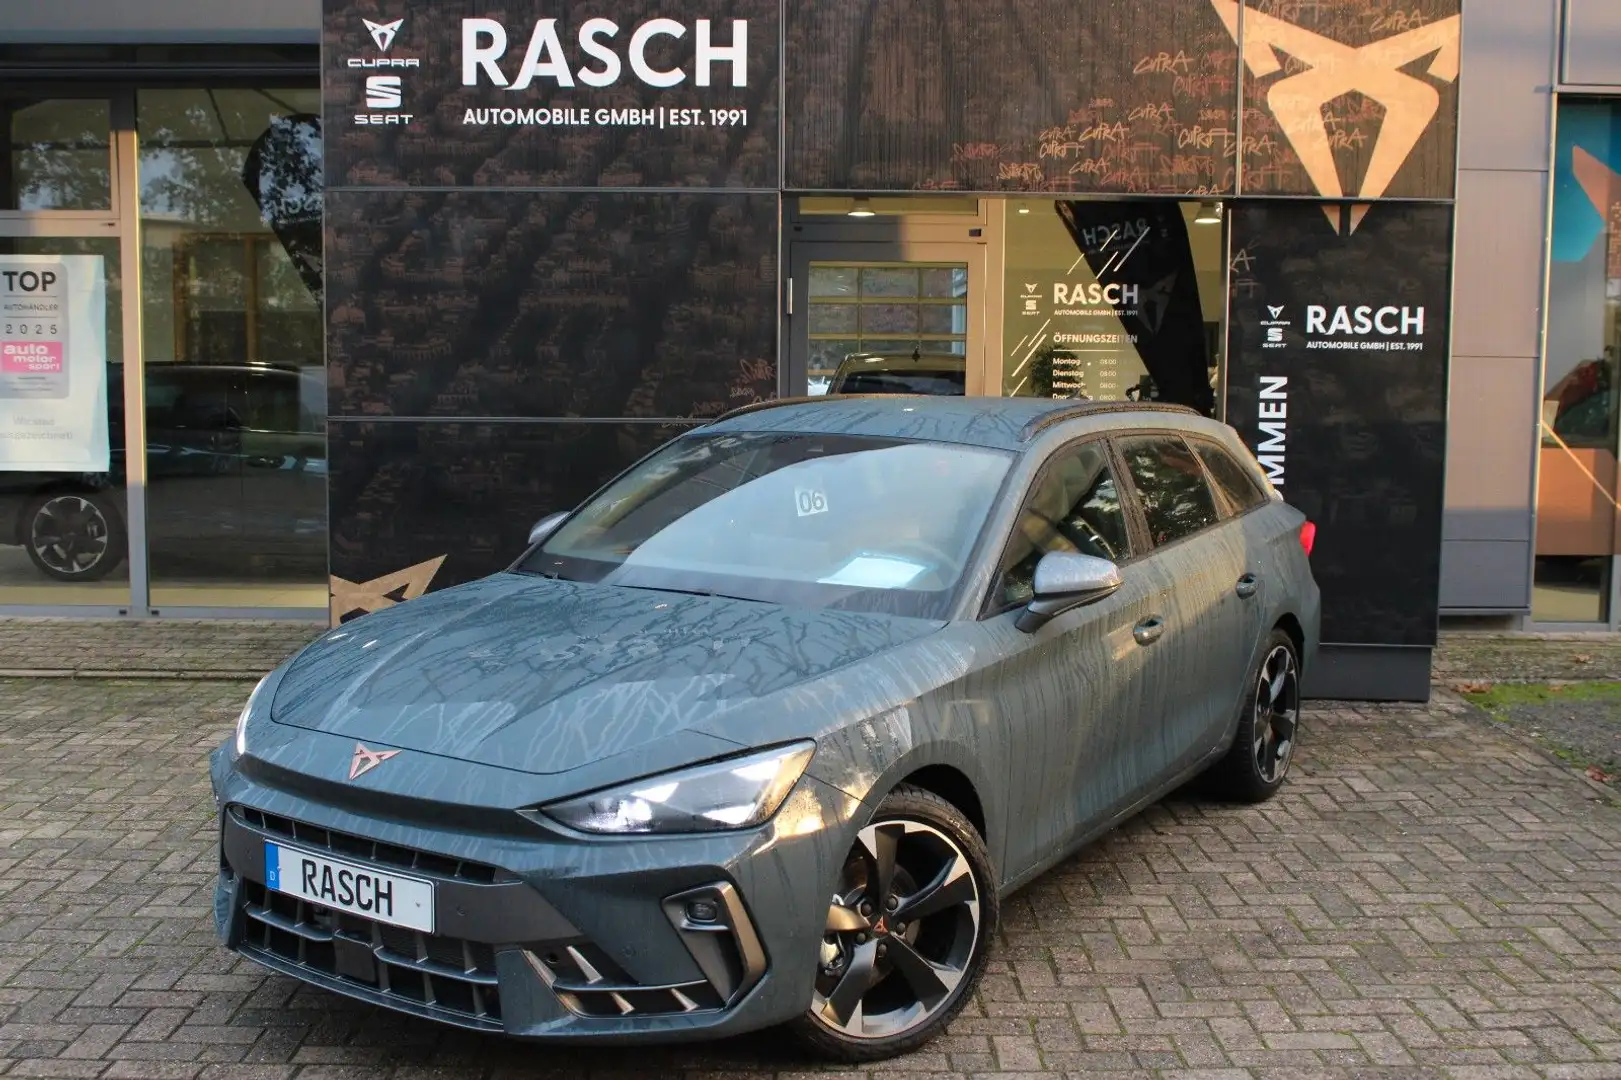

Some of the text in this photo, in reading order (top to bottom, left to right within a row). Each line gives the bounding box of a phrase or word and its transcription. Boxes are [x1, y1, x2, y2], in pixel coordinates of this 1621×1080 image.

[462, 18, 748, 90] RASCH
[348, 58, 419, 68] CUPRA
[354, 114, 413, 125] SEAT
[462, 107, 747, 126] AUTOMOBILE GMBH EST. 1991
[3, 271, 56, 291] TOP
[1053, 283, 1139, 305] RASCH
[1306, 305, 1425, 336] RASCH
[1053, 332, 1138, 343] ÖFFNUNGSZEITEN
[3, 344, 48, 355] auto
[1306, 341, 1424, 351] AUTOMOBILE GMBH EST. 1991
[13, 354, 57, 363] motor
[1053, 358, 1081, 366] Montag
[28, 362, 60, 370] sport
[1053, 370, 1084, 378] Dienstag
[269, 871, 276, 881] D
[301, 858, 392, 917] RASCH
